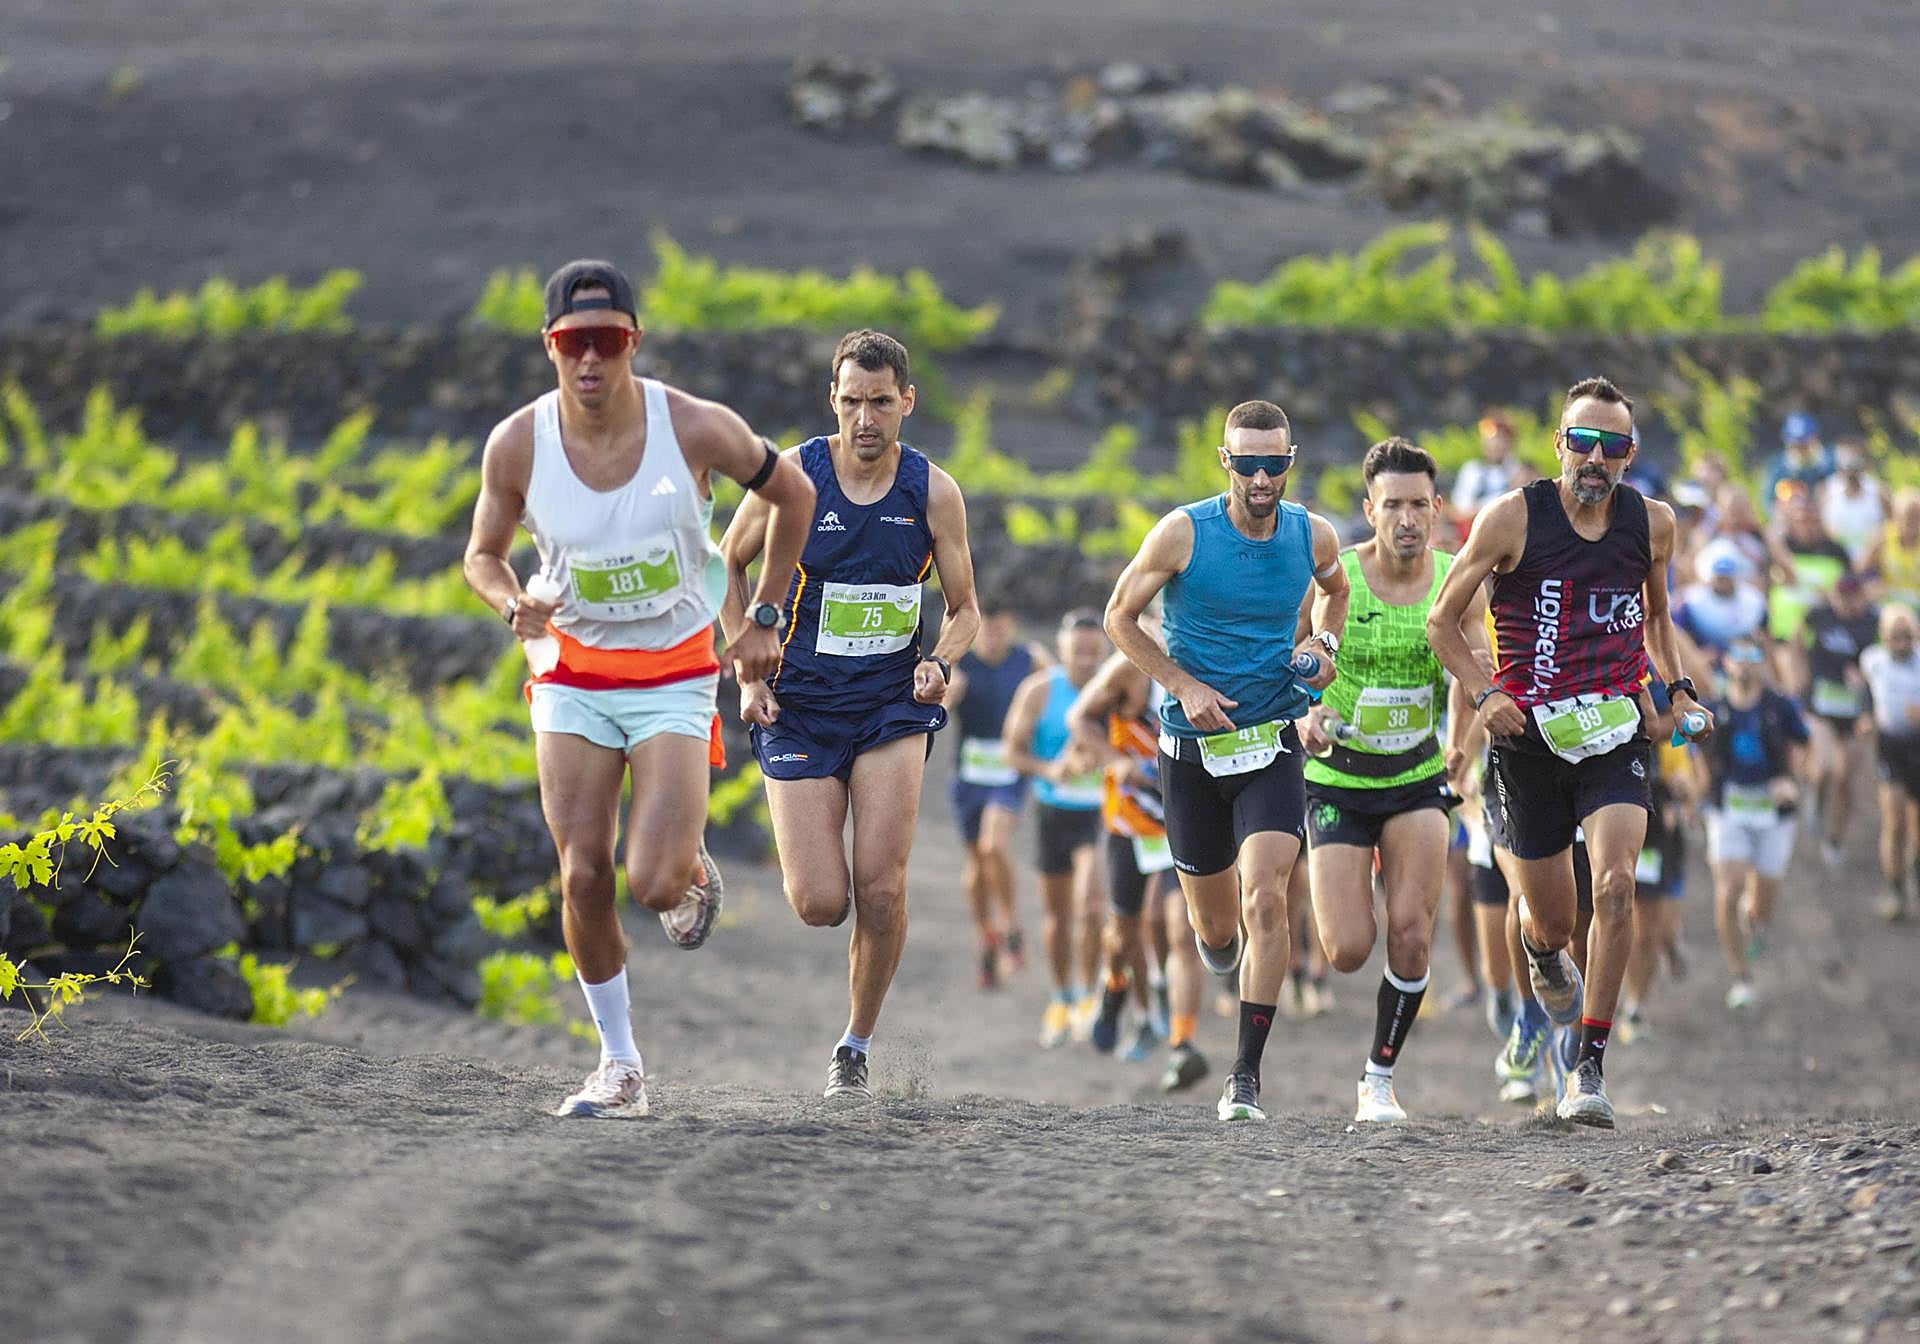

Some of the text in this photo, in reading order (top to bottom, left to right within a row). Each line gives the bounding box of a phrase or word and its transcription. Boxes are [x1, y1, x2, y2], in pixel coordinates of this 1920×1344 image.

[608, 568, 647, 595] 181
[861, 592, 873, 601] 23
[873, 592, 887, 601] Km
[861, 607, 883, 628] 75
[1387, 709, 1409, 728] 38
[1577, 707, 1602, 732] 89
[1238, 726, 1261, 742] 41
